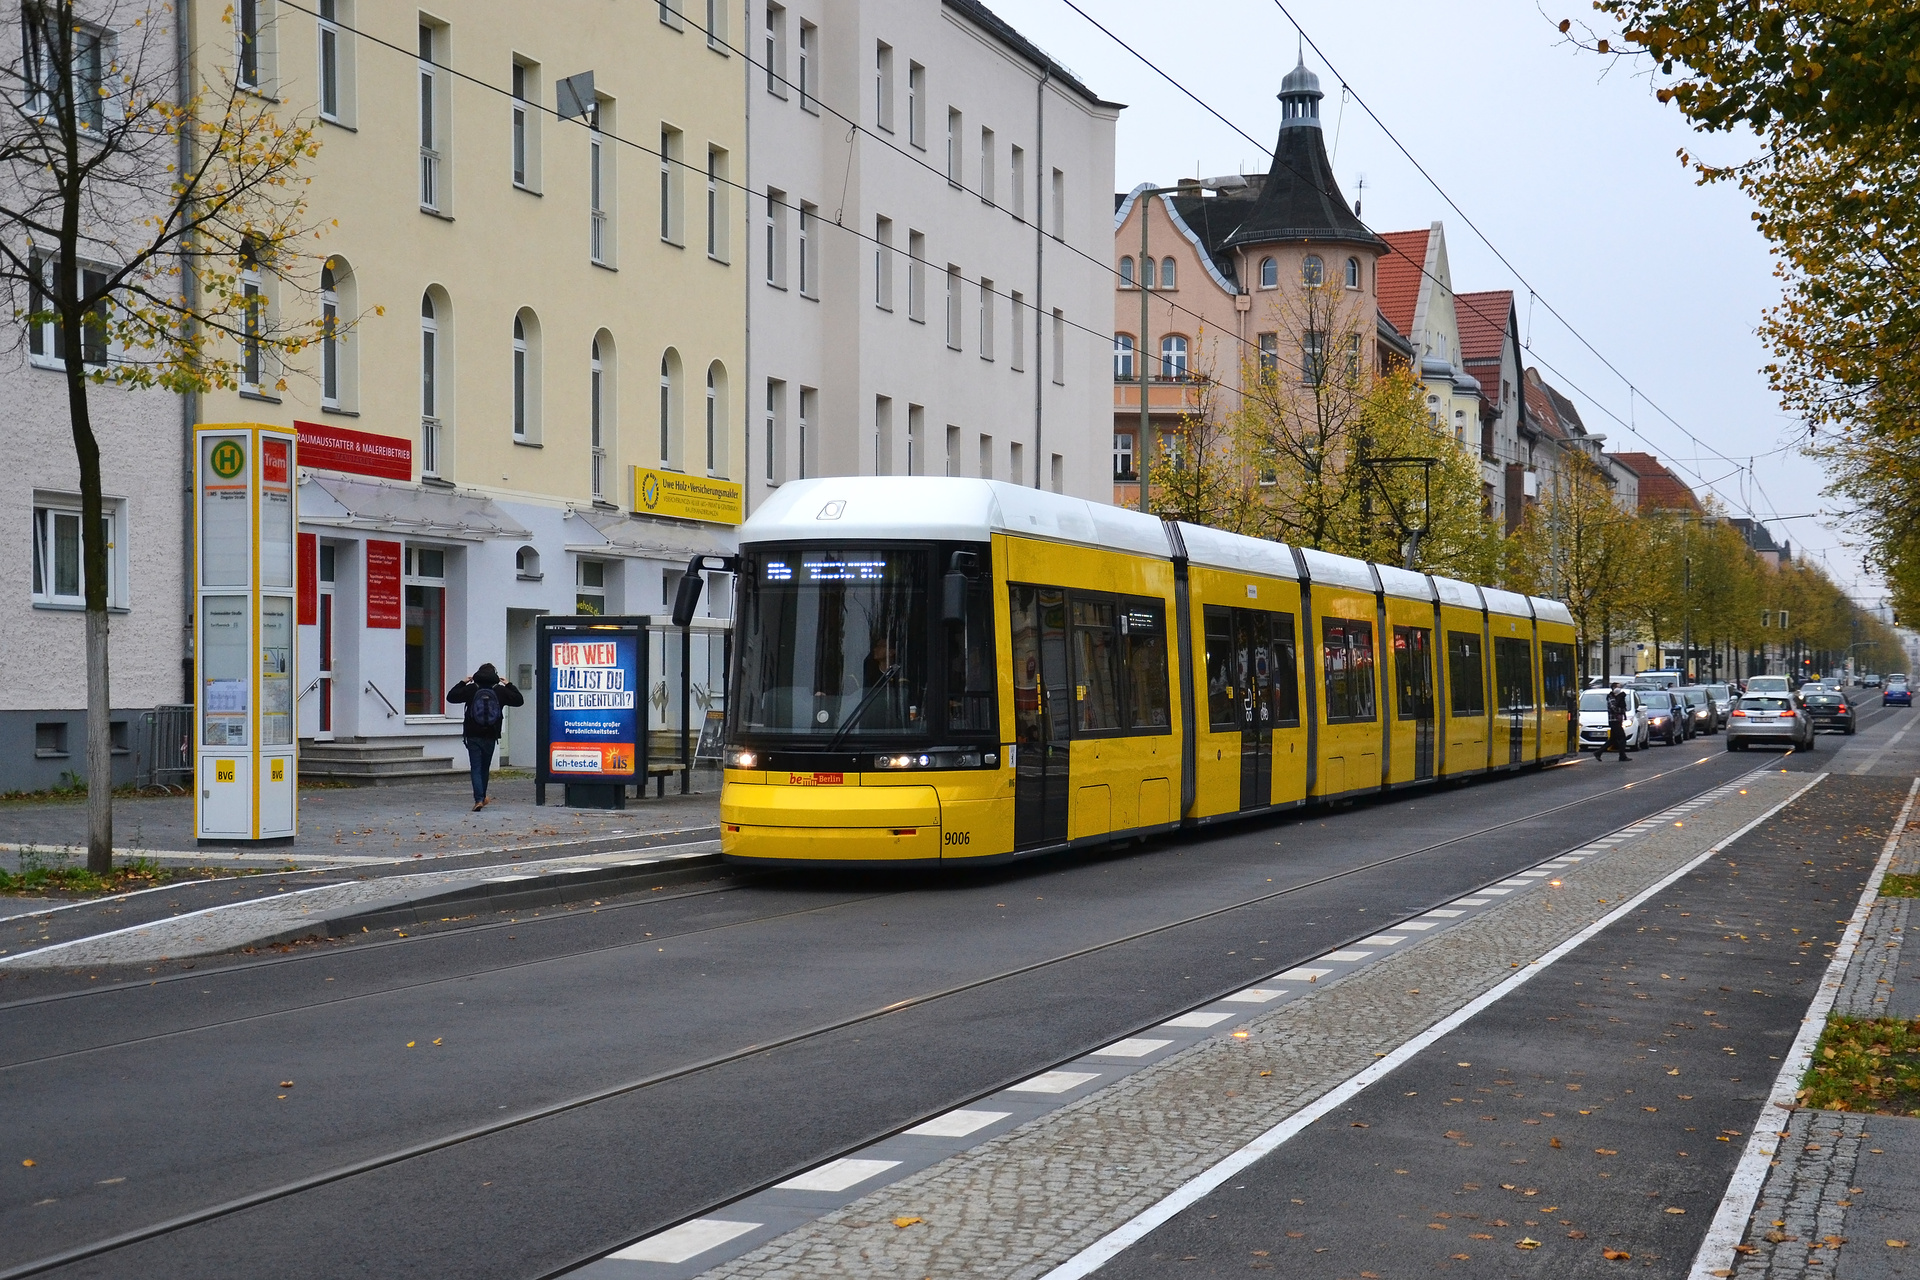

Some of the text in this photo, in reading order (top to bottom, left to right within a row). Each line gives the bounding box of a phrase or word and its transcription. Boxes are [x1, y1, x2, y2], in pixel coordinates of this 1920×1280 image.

[297, 432, 411, 460] RAUMAUSSTATTER & MALEREIBETRIEB
[220, 449, 236, 470] H
[265, 453, 286, 469] Tram
[662, 478, 739, 499] Uwe Holz Versicherungsmakler
[554, 641, 615, 666] FÜR WEN
[559, 666, 622, 690] HÄLTST DU
[555, 693, 632, 708] DICH EIGENTLICH?
[555, 758, 598, 768] ich-test.de
[612, 755, 628, 769] ils
[218, 771, 233, 781] BVG
[272, 770, 283, 780] BVG
[789, 772, 841, 785] be Berlin
[944, 831, 970, 846] 9006
